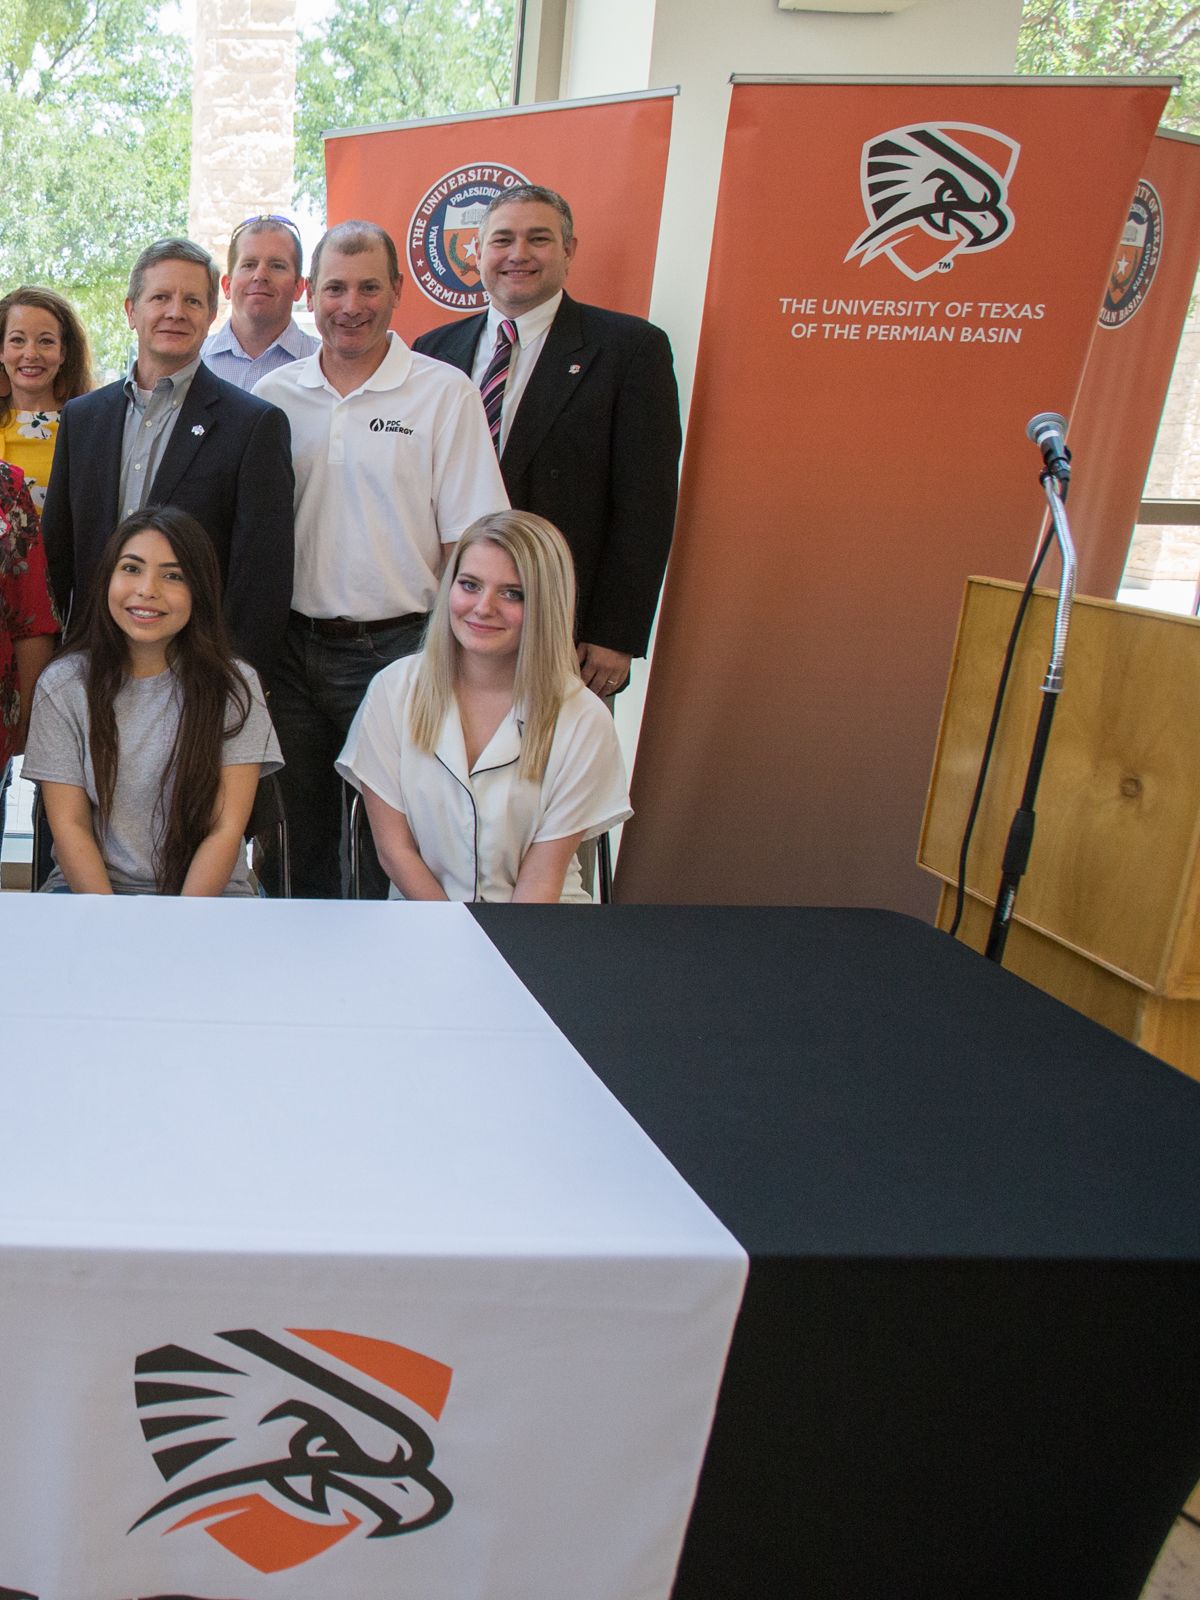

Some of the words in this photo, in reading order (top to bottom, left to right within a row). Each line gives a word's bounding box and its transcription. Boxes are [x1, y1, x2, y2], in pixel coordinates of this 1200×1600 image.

[450, 187, 501, 206] PRAESIDIU
[412, 218, 427, 248] THE
[421, 168, 502, 215] UNIVERSITY
[428, 225, 447, 276] DISCIPLINA
[937, 261, 952, 270] TM
[421, 271, 478, 305] PERMIAN
[779, 298, 818, 315] THE
[821, 299, 941, 317] UNIVERSITY
[945, 301, 973, 318] OF
[977, 302, 1046, 320] TEXAS
[791, 323, 818, 339] OF
[821, 323, 861, 340] THE
[866, 325, 955, 342] PERMIAN
[959, 327, 1023, 344] BASIN
[385, 426, 413, 435] ENERGY
